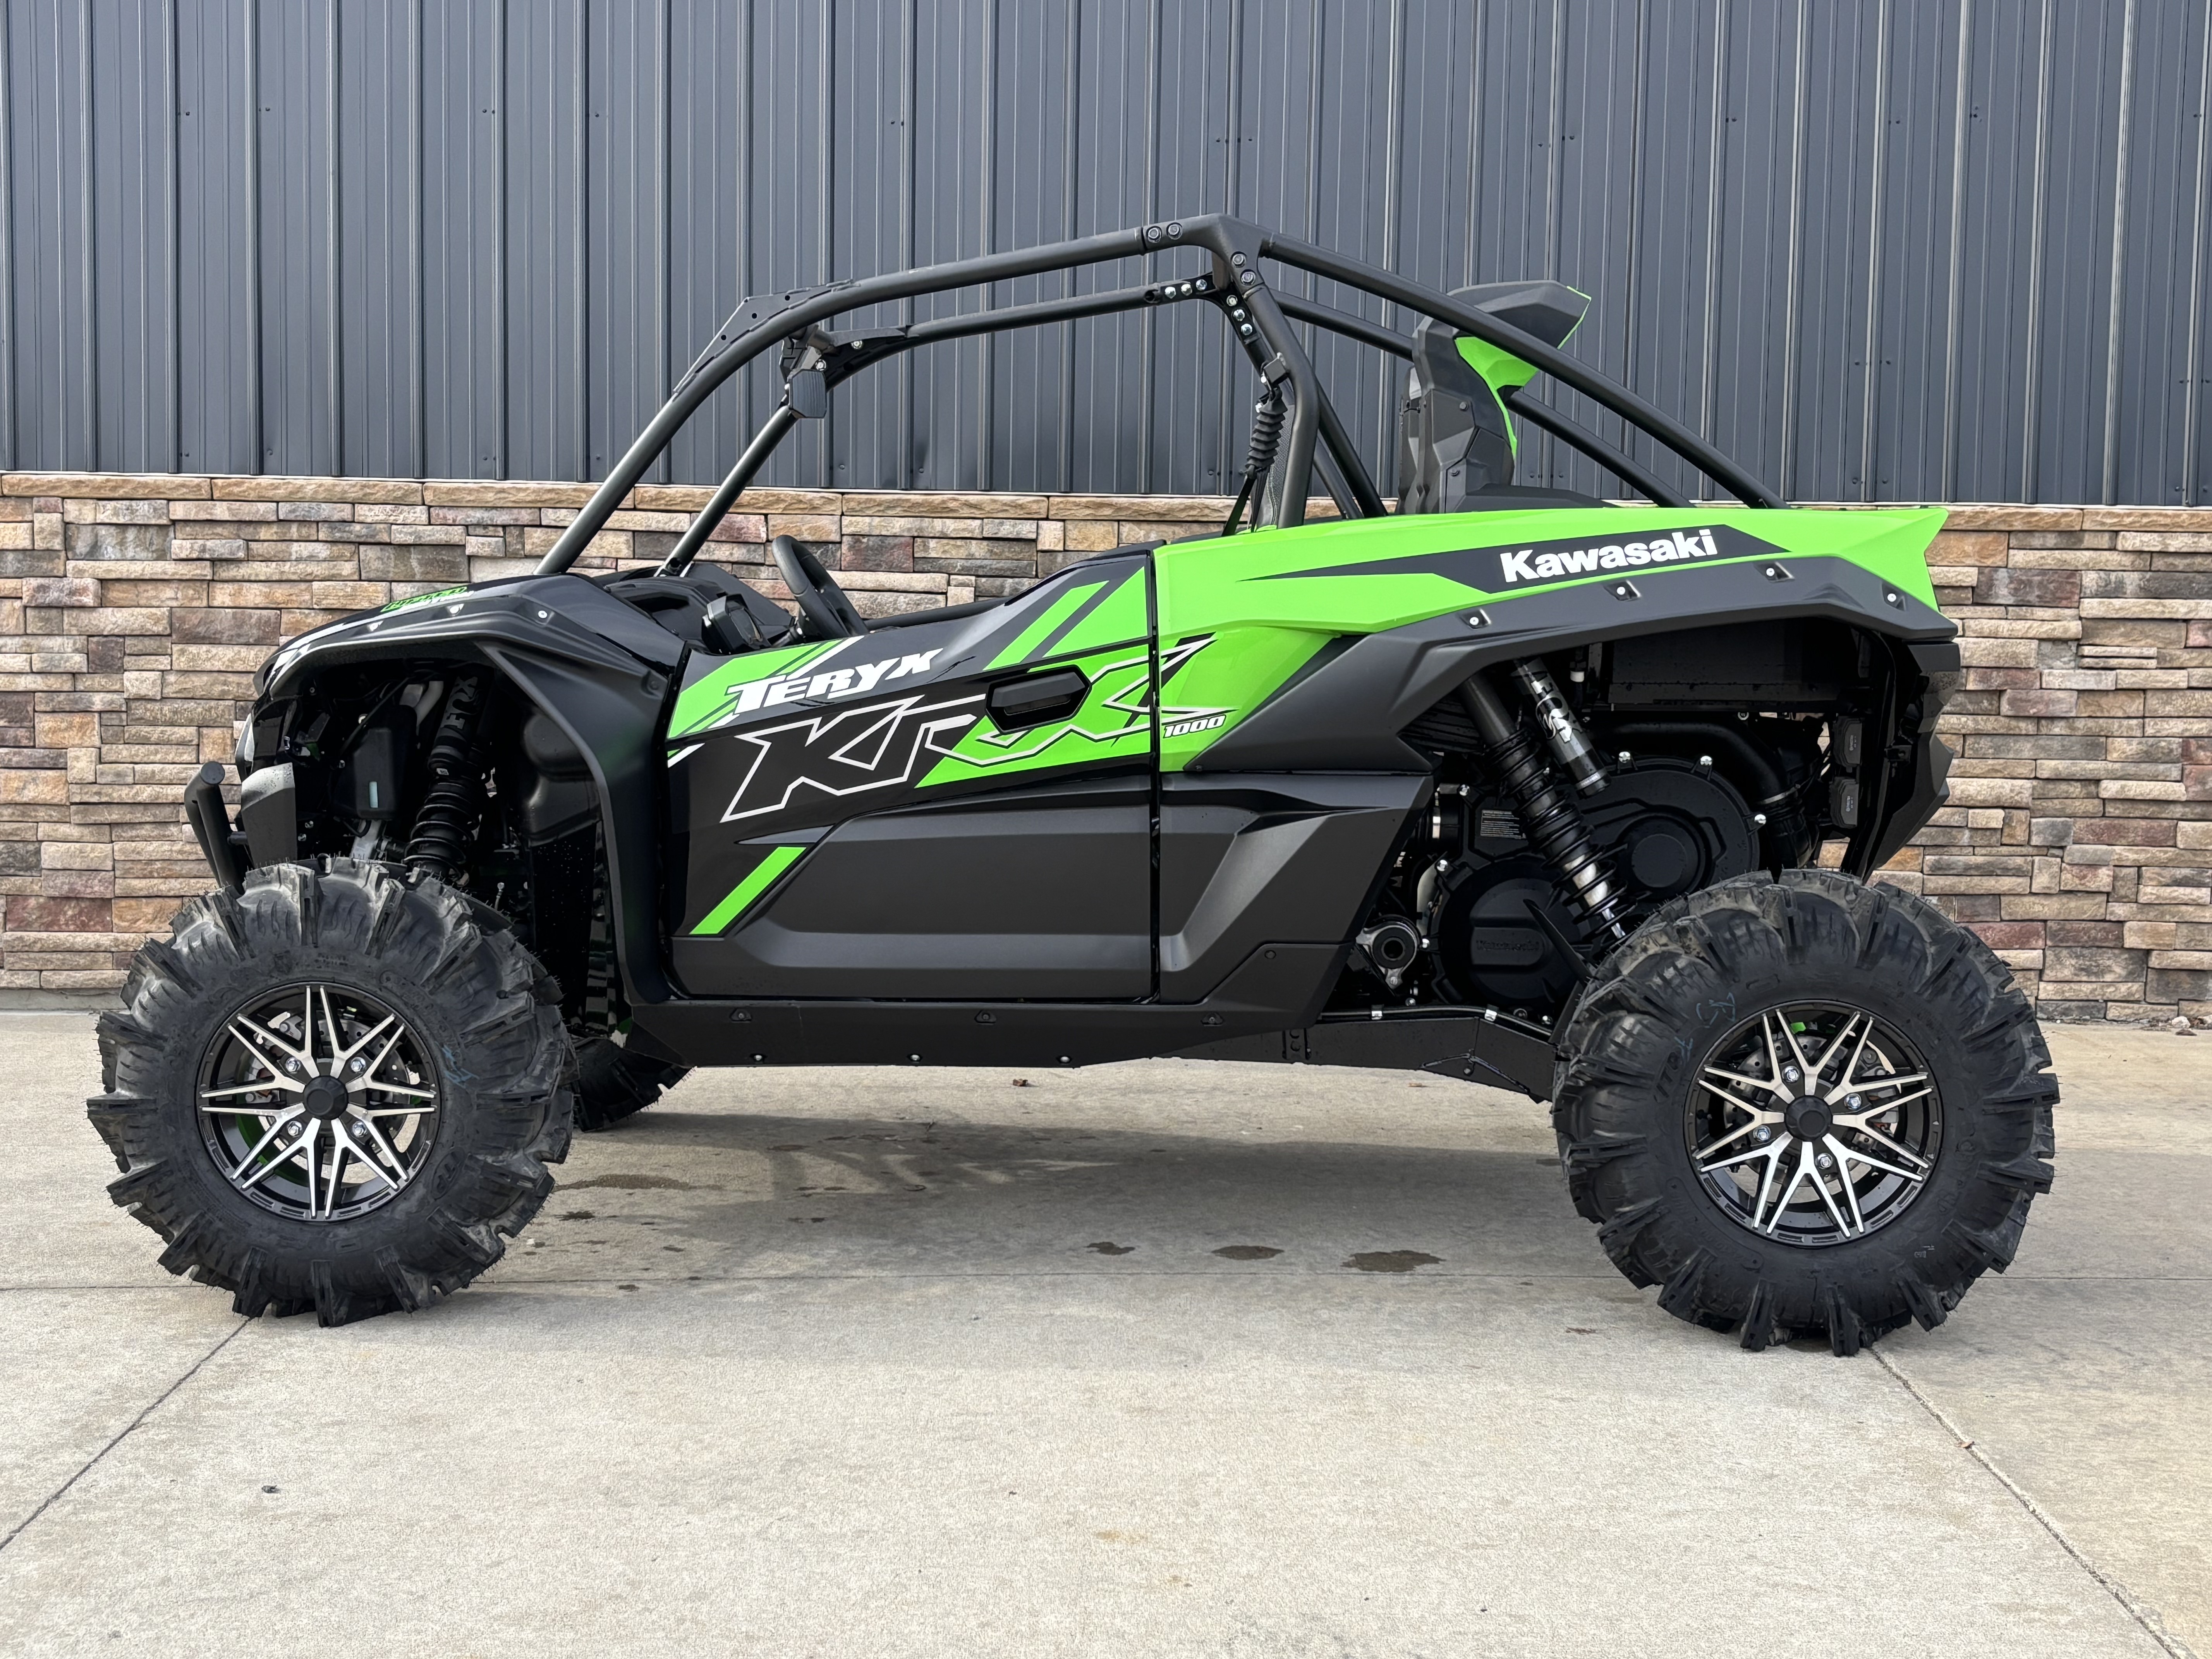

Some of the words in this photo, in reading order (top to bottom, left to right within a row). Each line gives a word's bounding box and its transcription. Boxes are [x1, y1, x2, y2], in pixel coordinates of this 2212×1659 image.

[1500, 529, 1718, 583] Kawasaki
[440, 676, 480, 730] FOX
[726, 648, 943, 714] TERYX
[1163, 714, 1227, 738] 1000
